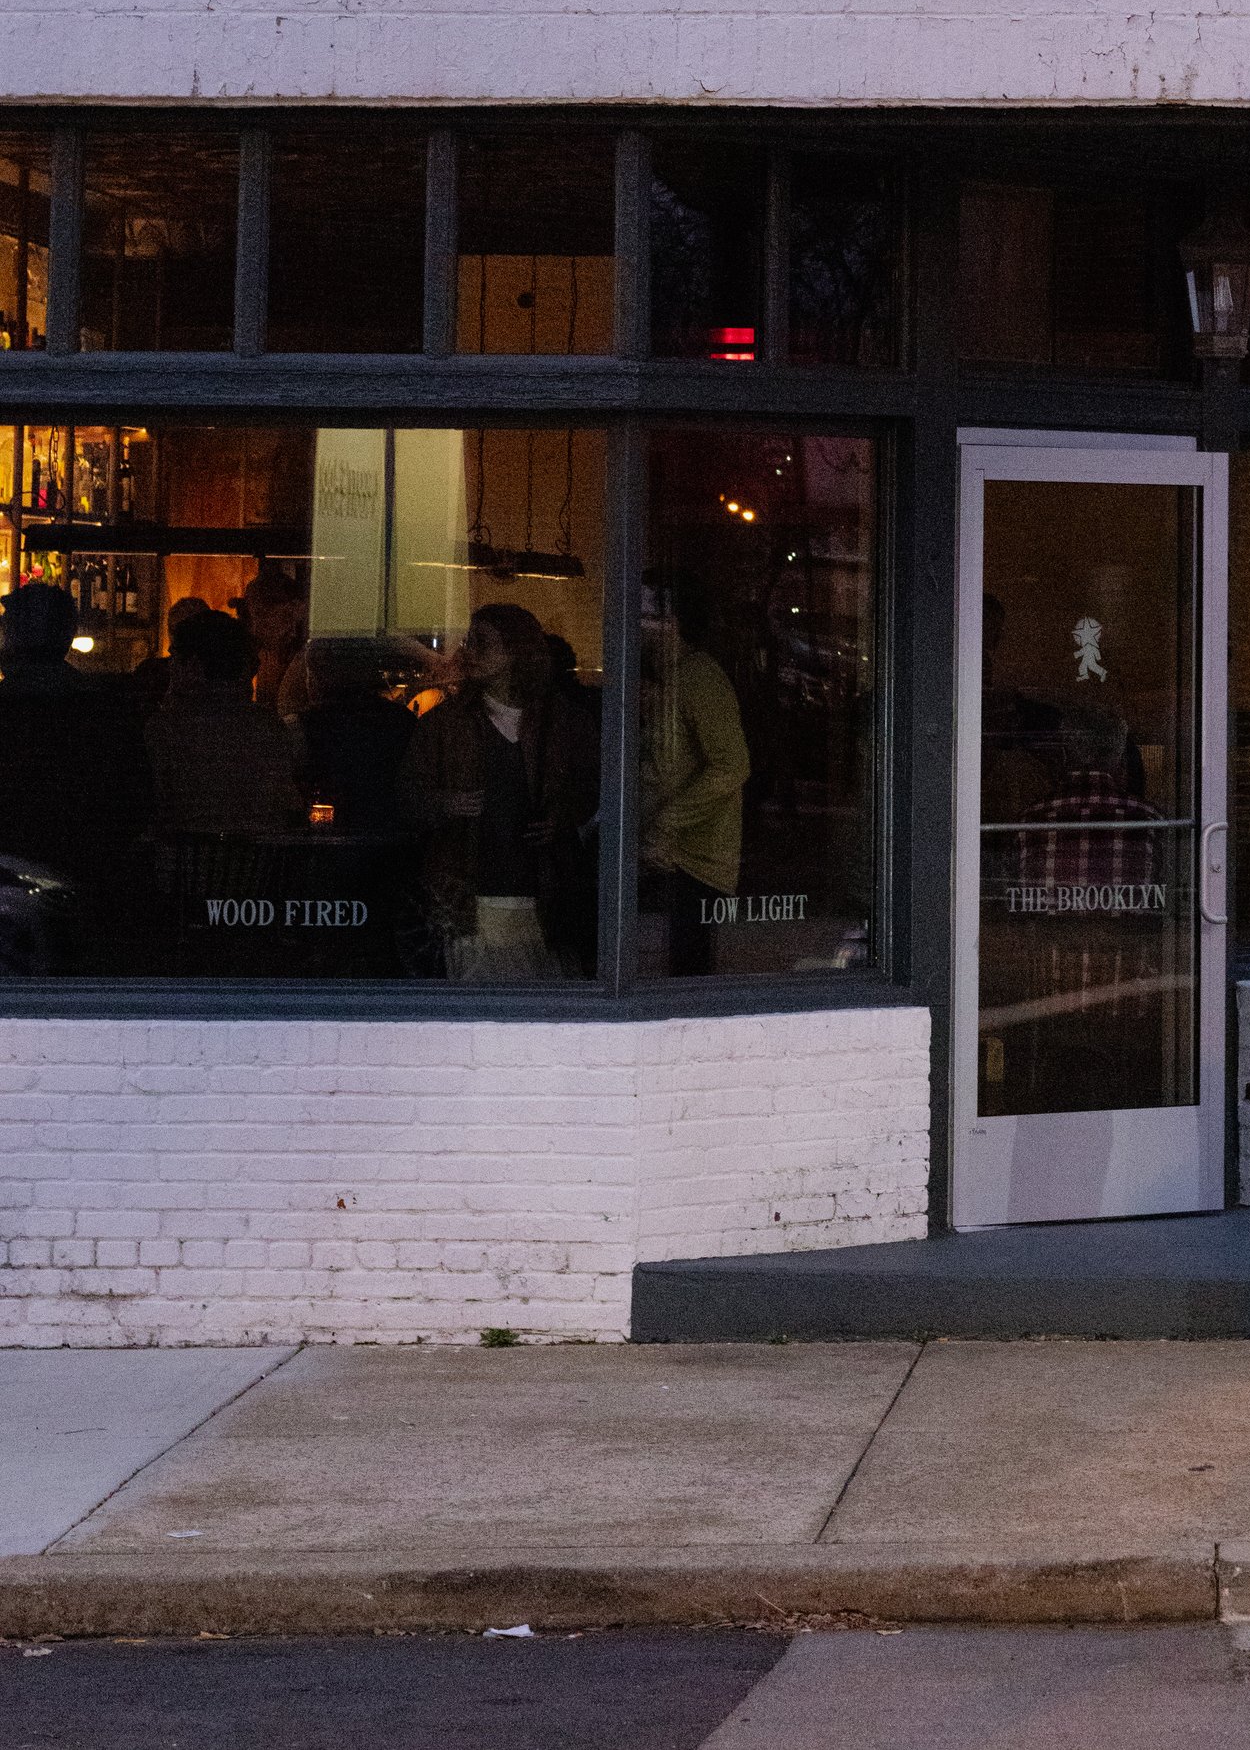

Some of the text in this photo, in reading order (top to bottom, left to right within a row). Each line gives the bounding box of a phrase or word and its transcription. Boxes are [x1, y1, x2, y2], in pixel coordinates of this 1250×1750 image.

[206, 898, 368, 927] WOOD FIRED
[700, 894, 808, 925] LOW LIGHT
[1007, 884, 1167, 913] THE BROOKLYN
